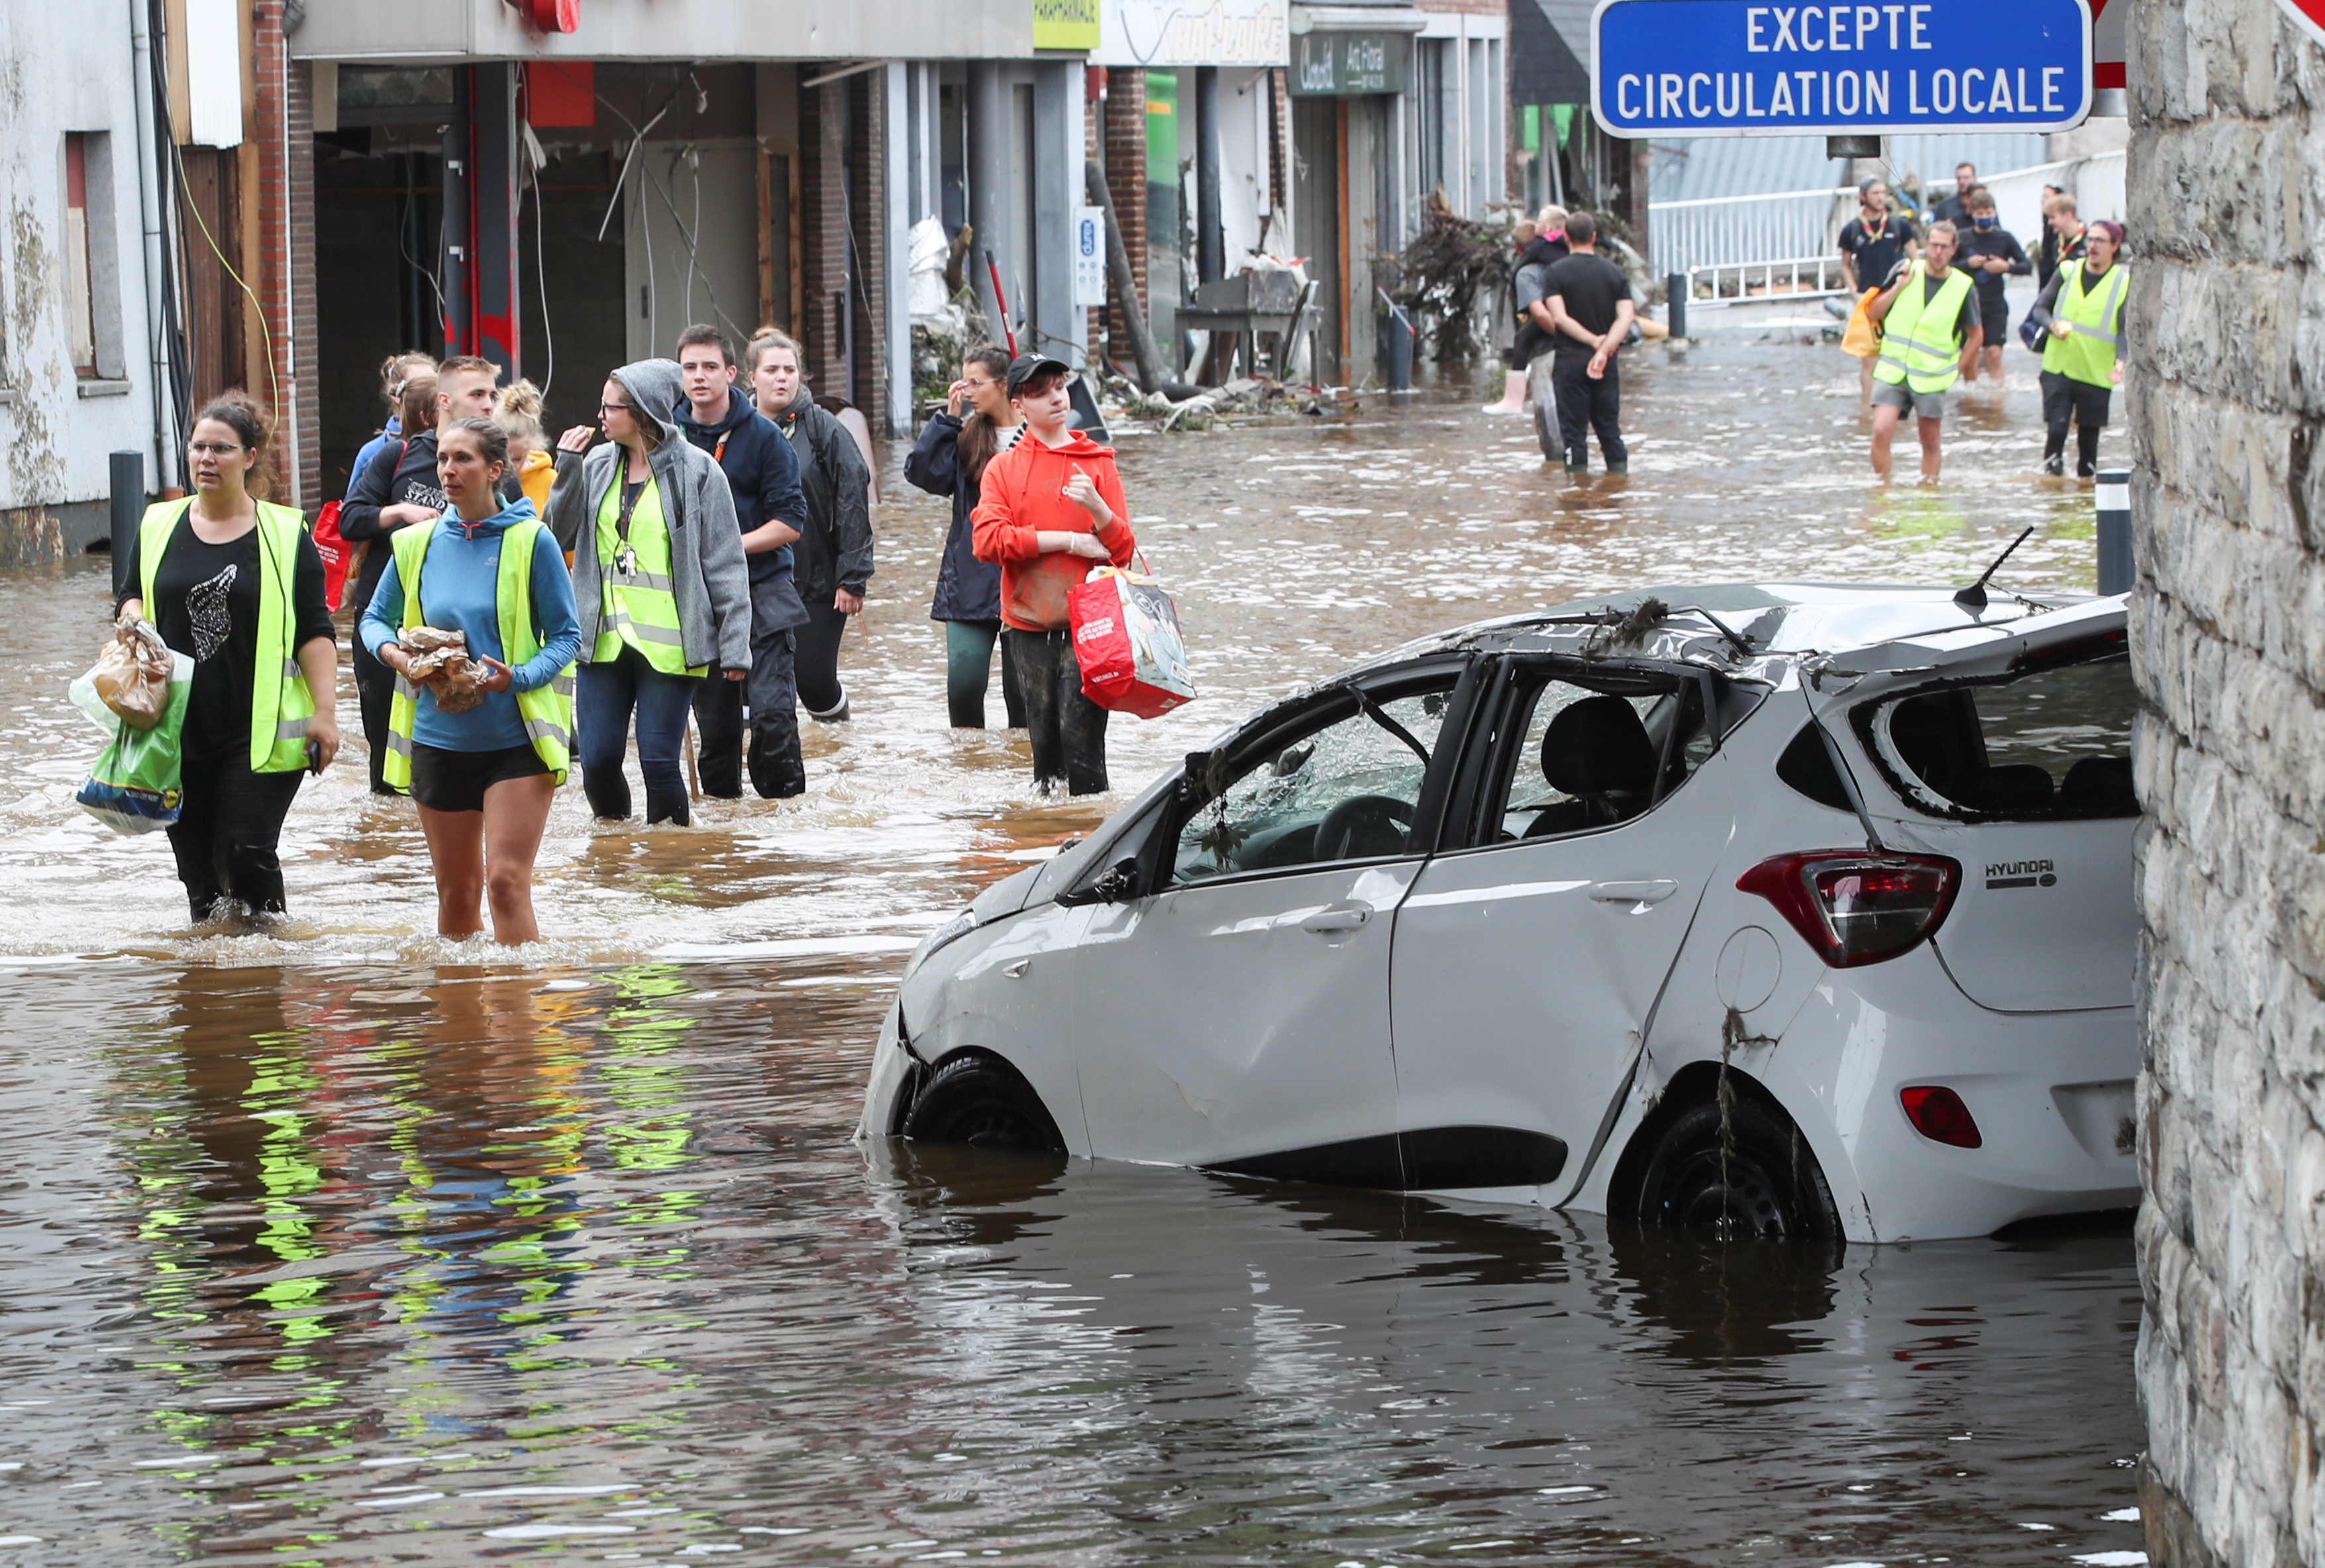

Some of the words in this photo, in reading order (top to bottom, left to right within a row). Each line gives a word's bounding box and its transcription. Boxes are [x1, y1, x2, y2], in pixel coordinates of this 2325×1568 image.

[1747, 5, 1933, 52] EXCEPTE
[1618, 70, 1889, 119] CIRCULATION
[1909, 67, 2065, 114] LOCALE
[404, 490, 446, 510] STAND
[1984, 859, 2053, 876] HYUNDAI
